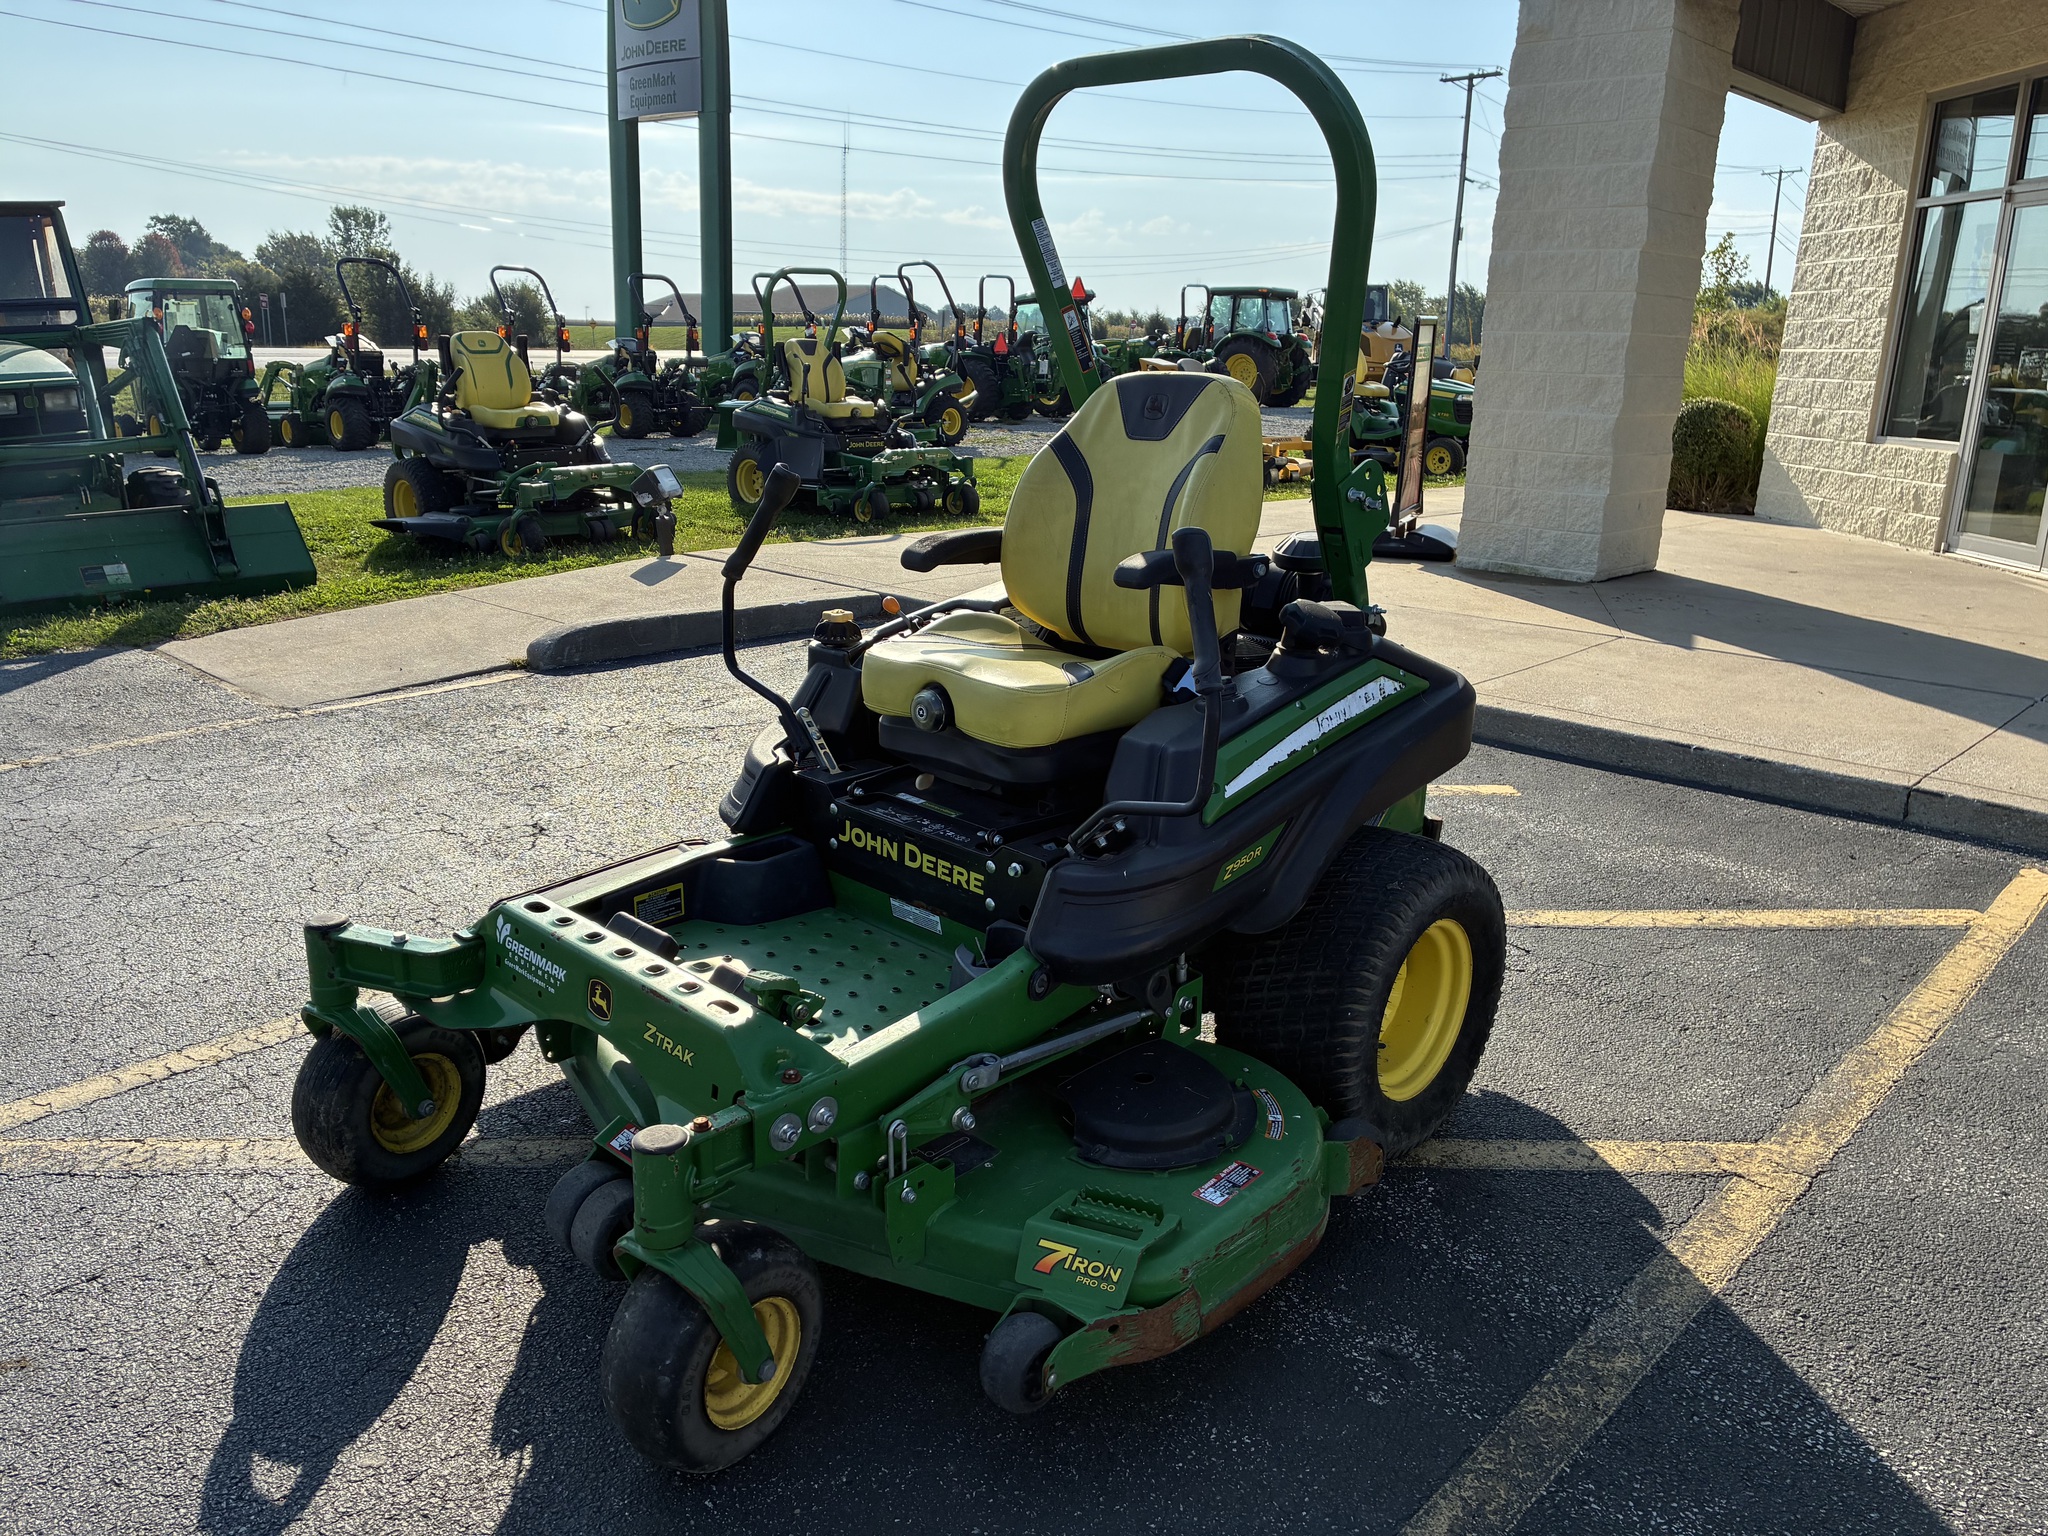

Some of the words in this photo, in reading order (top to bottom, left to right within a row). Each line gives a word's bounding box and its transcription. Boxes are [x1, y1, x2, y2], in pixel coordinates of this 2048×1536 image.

[621, 44, 645, 61] JOHN
[646, 39, 686, 56] DEERE
[629, 71, 677, 91] GreenMark
[630, 90, 677, 111] Equipment
[849, 441, 865, 449] JOHN
[865, 440, 885, 448] DEERE
[838, 820, 899, 862] JOHN
[904, 842, 985, 895] DEERE
[1223, 846, 1263, 880] Z950R
[505, 936, 567, 982] GREENMARK
[643, 1022, 696, 1067] ZTRAK
[1075, 1275, 1099, 1288] PRO
[1099, 1282, 1116, 1293] 60
